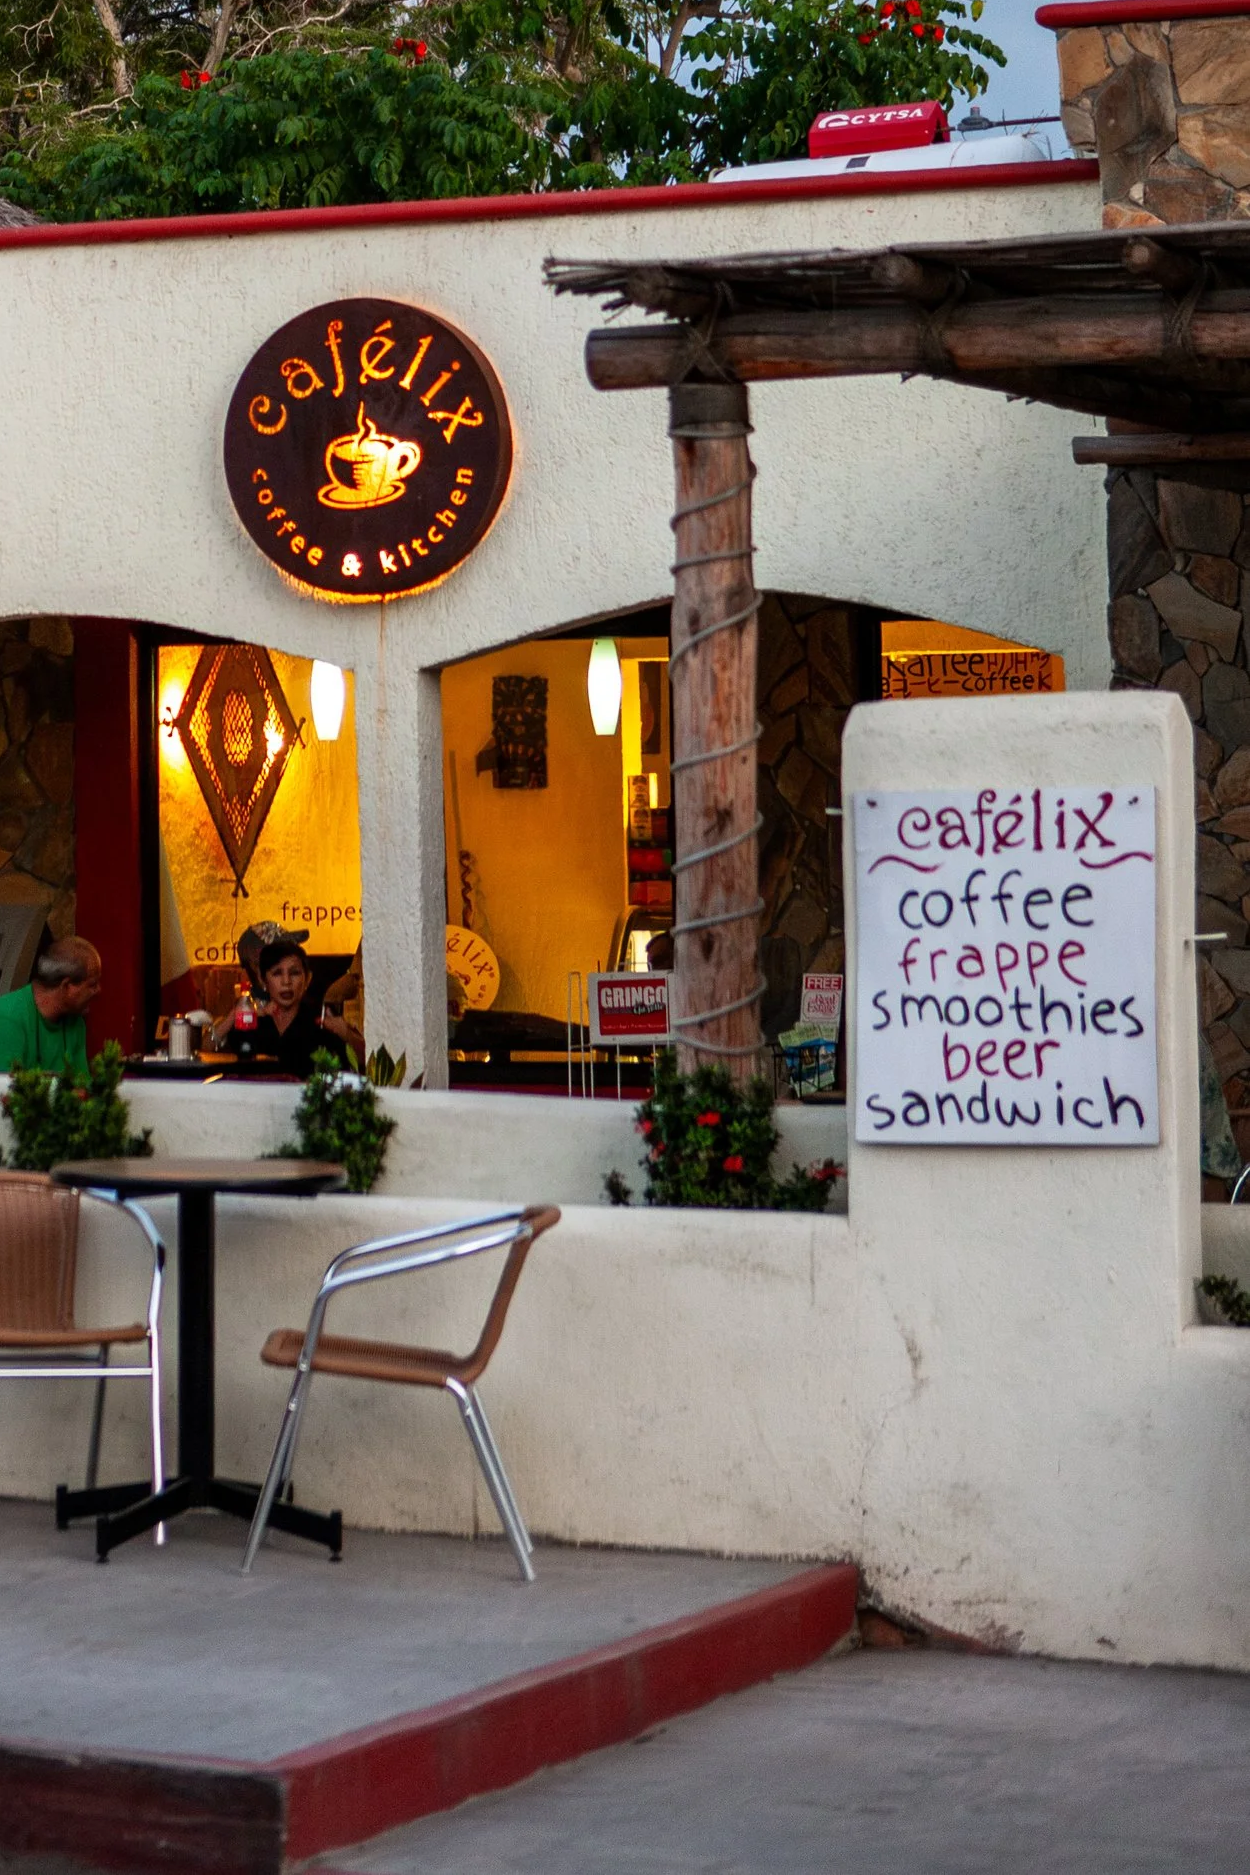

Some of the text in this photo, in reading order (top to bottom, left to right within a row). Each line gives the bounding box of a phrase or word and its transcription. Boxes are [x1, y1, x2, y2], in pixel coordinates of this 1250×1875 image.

[851, 108, 924, 125] CYTSA
[249, 319, 483, 444] cafélix
[253, 468, 473, 576] coffee & kitchen
[897, 788, 1117, 857] cafélix
[899, 868, 1095, 931] coffee
[194, 941, 238, 962] coff
[446, 932, 494, 976] élix
[898, 937, 1088, 993] frappe
[600, 986, 667, 1008] GRINGO
[806, 976, 840, 990] FREE
[872, 984, 1146, 1037] smoothies
[943, 1031, 1060, 1082] beer
[866, 1077, 1146, 1130] sandwich
